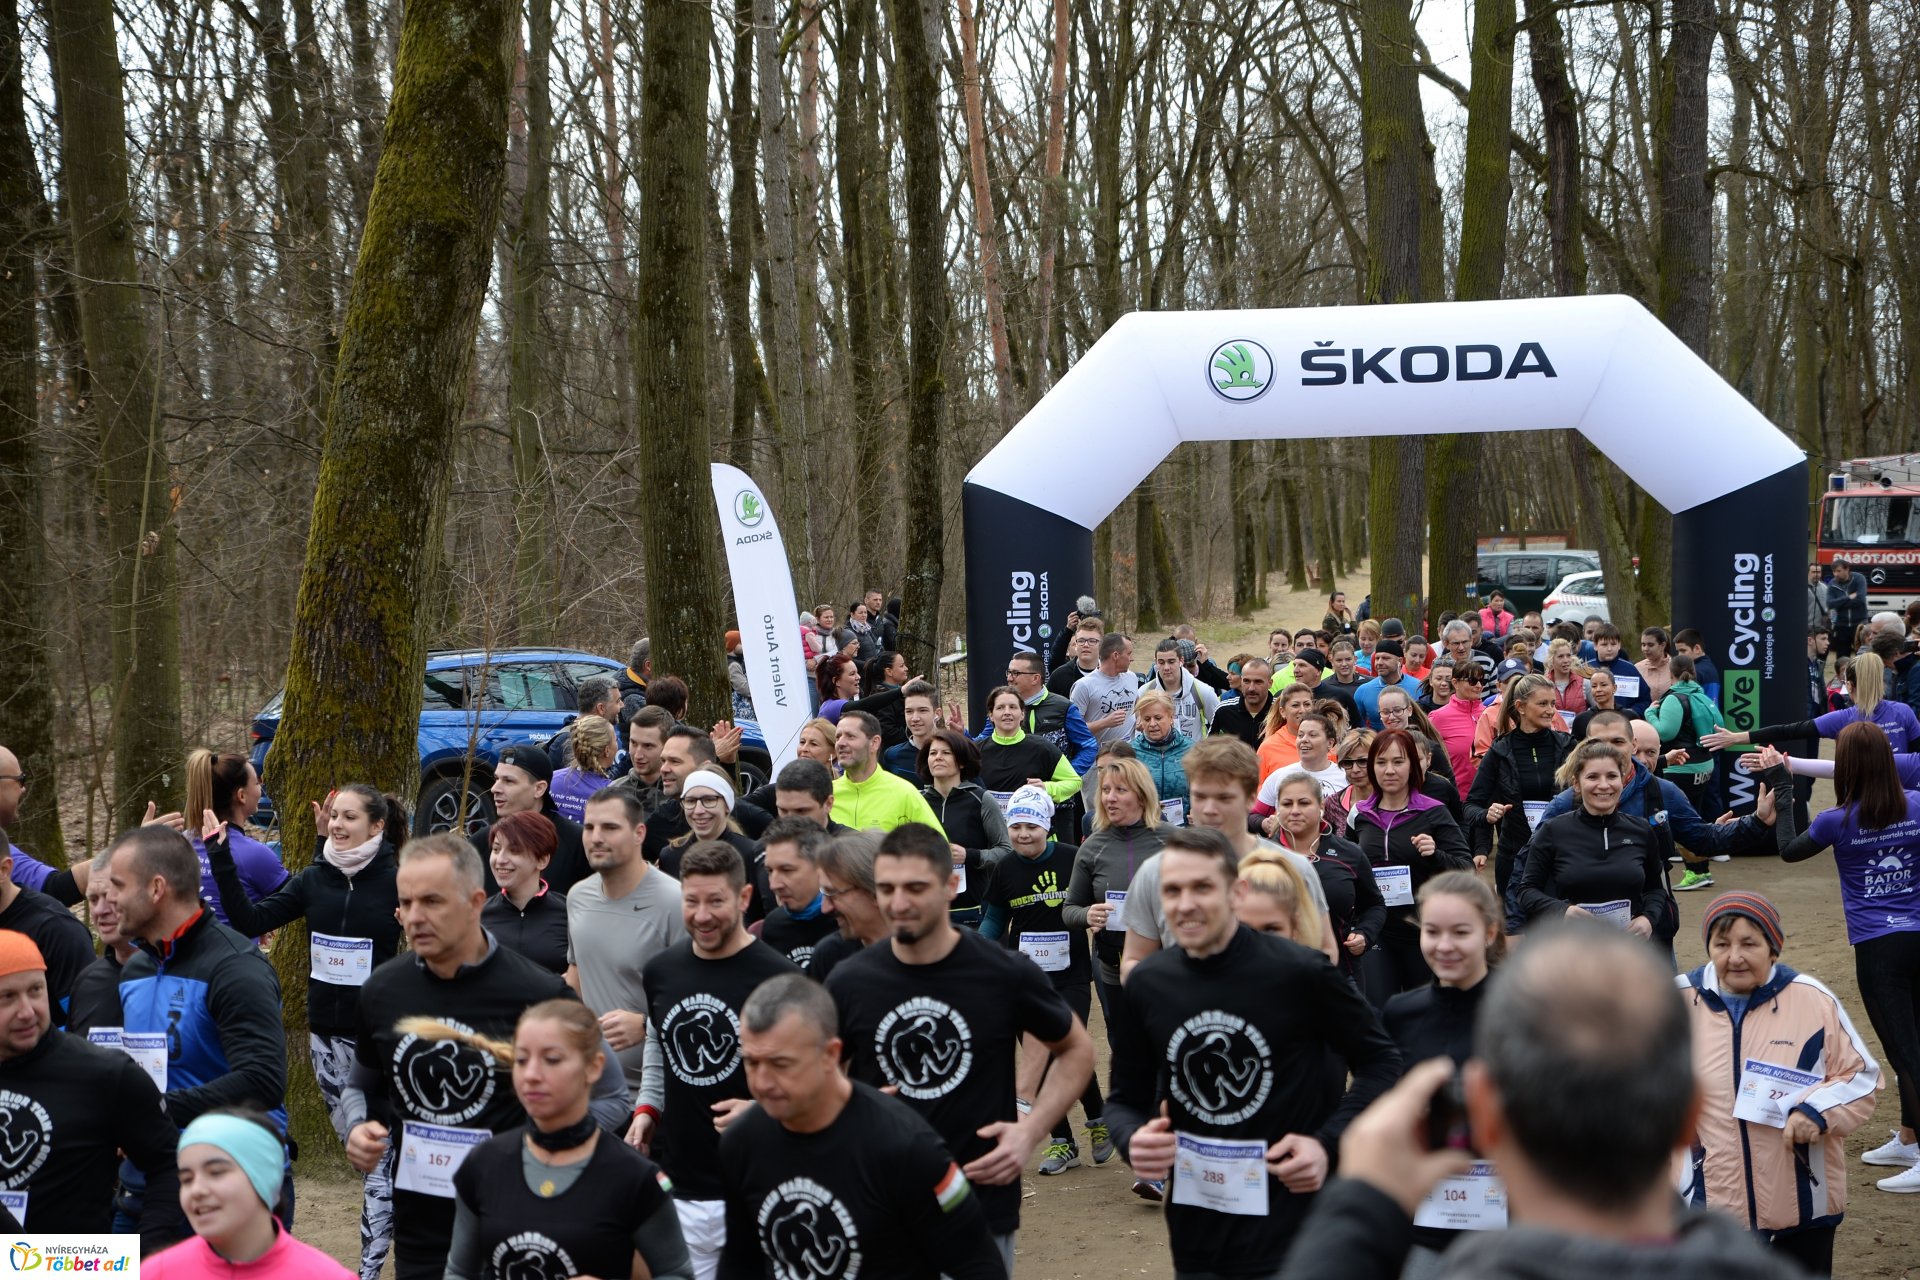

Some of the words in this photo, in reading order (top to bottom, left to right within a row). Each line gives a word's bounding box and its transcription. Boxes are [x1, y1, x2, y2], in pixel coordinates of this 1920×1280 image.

[1300, 340, 1558, 387] ŠKODA
[1762, 553, 1774, 604] ŠKODA
[1038, 571, 1049, 621] ŠKODA
[1728, 553, 1760, 666] Cycling
[1035, 949, 1049, 957] 210
[328, 957, 345, 966] 284
[1750, 1064, 1773, 1076] SPURI
[1772, 1070, 1815, 1085] NYÍREGYHÁZ
[1768, 1089, 1790, 1101] 22
[428, 1153, 452, 1167] 167
[1202, 1169, 1225, 1185] 288
[1443, 1189, 1467, 1202] 104
